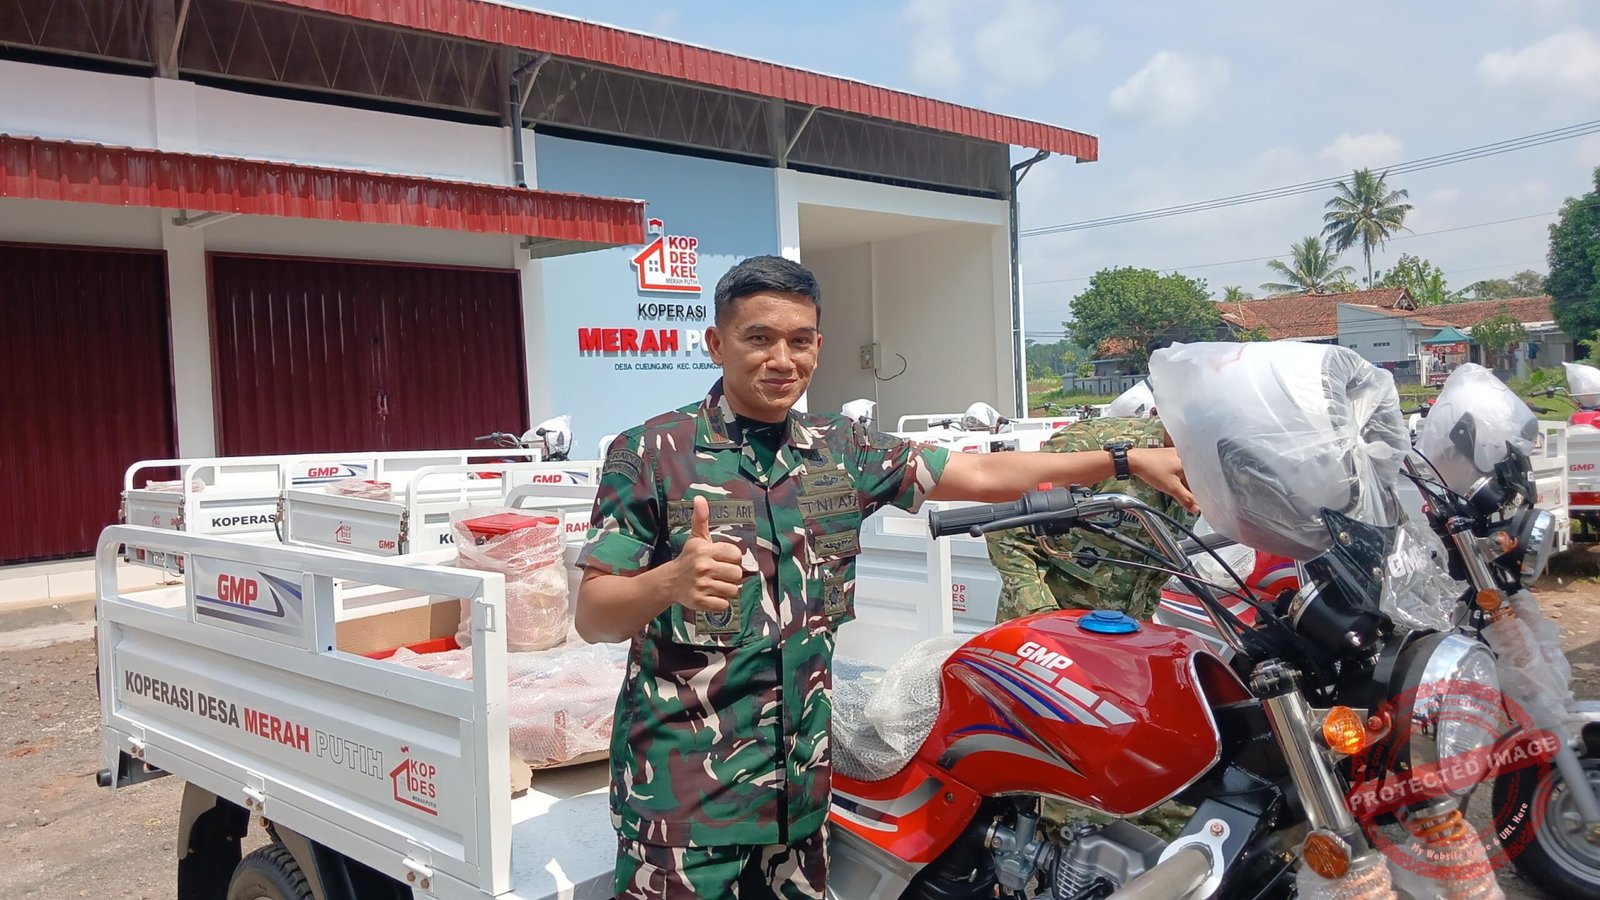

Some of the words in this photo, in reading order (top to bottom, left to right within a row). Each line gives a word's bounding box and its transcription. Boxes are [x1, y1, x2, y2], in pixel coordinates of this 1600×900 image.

[668, 236, 697, 250] KOP
[670, 251, 697, 265] DES
[670, 265, 697, 278] KEL
[638, 303, 707, 318] KOPERASI
[578, 328, 679, 352] MERAH
[614, 363, 633, 371] DESA
[308, 466, 339, 478] GMP
[1569, 463, 1595, 471] GMP
[532, 474, 562, 484] GMP
[801, 497, 833, 513] TNI
[838, 494, 857, 509] AD
[212, 514, 276, 527] KOPERAS
[565, 522, 589, 532] RAH
[378, 540, 396, 549] GMP
[217, 573, 258, 605] GMP
[952, 583, 966, 592] OP
[952, 593, 966, 603] ES
[1016, 641, 1073, 670] GMP
[125, 670, 194, 712] KOPERASI
[198, 692, 240, 728] DESA
[244, 707, 310, 753] MERAH
[315, 730, 384, 780] PUTIH
[410, 759, 436, 779] KOP
[411, 777, 436, 798] DES
